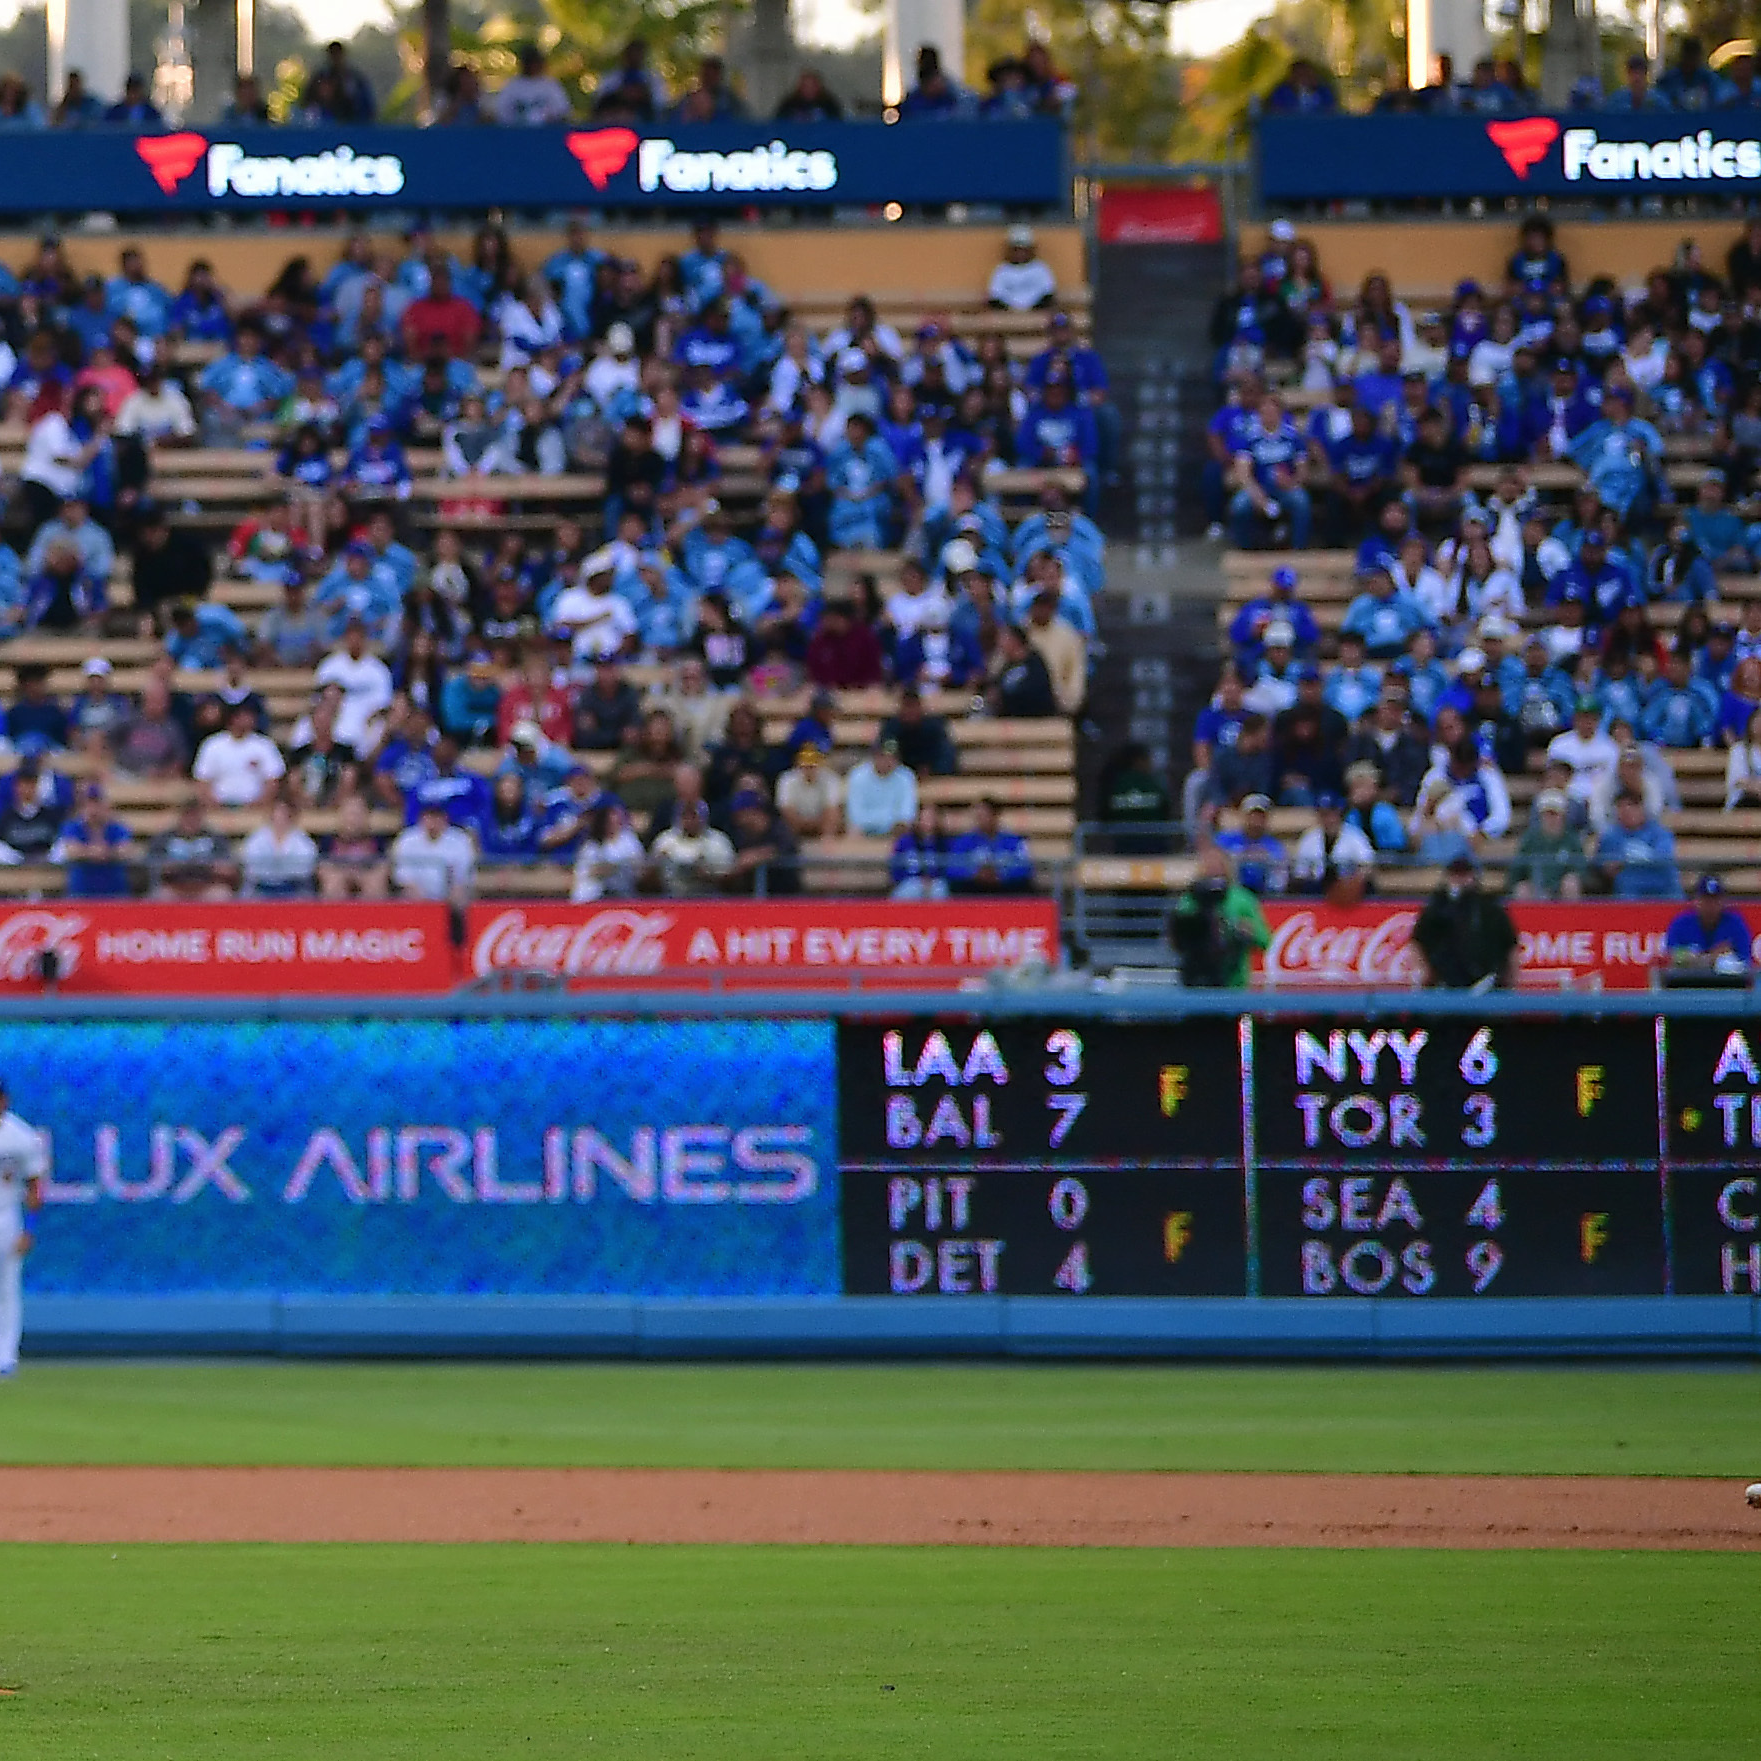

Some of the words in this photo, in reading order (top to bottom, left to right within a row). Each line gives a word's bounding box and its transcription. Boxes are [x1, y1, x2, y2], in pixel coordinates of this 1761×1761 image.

[207, 143, 394, 197] Fanatics
[639, 139, 838, 191] Fanatics
[1563, 128, 1761, 180] Fanatics
[96, 929, 210, 963] HOME
[217, 929, 296, 963] RUN
[301, 928, 425, 963] MAGIC
[473, 909, 676, 976] Coca-Cola
[686, 927, 717, 964] A
[725, 927, 798, 964] HIT
[803, 926, 934, 964] EVERY
[948, 926, 1049, 964] TIME
[1516, 930, 1594, 964] OME
[1604, 932, 1666, 964] RU
[883, 1029, 1010, 1086] LAA
[1044, 1028, 1084, 1085] 3
[1295, 1029, 1429, 1084] NYY
[1459, 1026, 1499, 1084] 6
[1158, 1065, 1189, 1118] F
[1576, 1065, 1605, 1116] F
[885, 1093, 1004, 1148] BAL
[1046, 1091, 1087, 1148] 7
[1294, 1092, 1427, 1148] TOR
[1460, 1092, 1497, 1148] 3
[283, 1126, 819, 1204] AIRLINES
[888, 1177, 975, 1231] PIT
[1048, 1177, 1089, 1231] 0
[1301, 1176, 1424, 1232] SEA
[1466, 1178, 1506, 1231] 4
[1163, 1210, 1193, 1262] F
[1580, 1212, 1609, 1263] F
[890, 1240, 1006, 1293] DET
[1053, 1241, 1094, 1293] 4
[1300, 1240, 1437, 1294] BOS
[1465, 1240, 1503, 1293] 9
